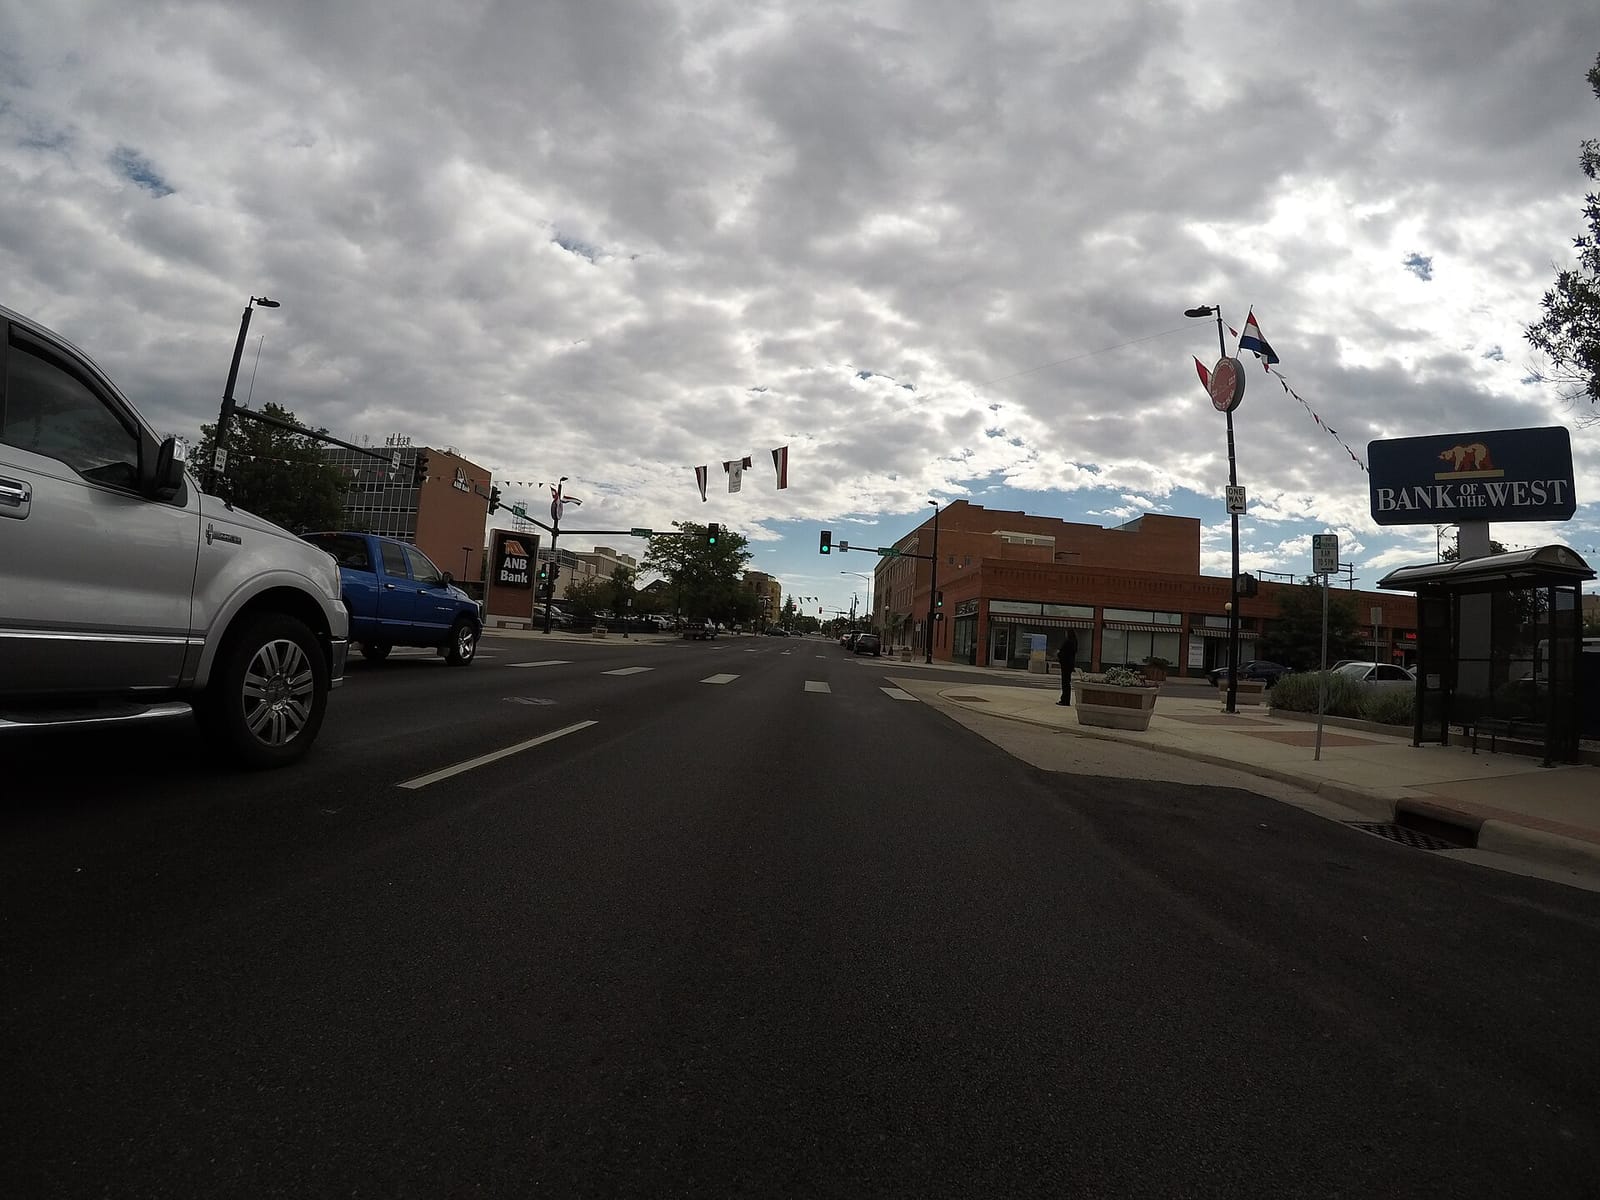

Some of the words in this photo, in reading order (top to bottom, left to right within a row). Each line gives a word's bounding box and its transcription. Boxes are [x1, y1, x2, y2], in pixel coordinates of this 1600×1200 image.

[1228, 487, 1244, 496] ONE
[1460, 483, 1479, 496] OF
[1483, 480, 1568, 506] WEST
[1228, 495, 1244, 503] WAY
[1376, 485, 1457, 511] BANK
[1456, 495, 1487, 508] THE
[1314, 537, 1320, 547] 2
[503, 557, 527, 571] ANB
[500, 570, 528, 584] Bank
